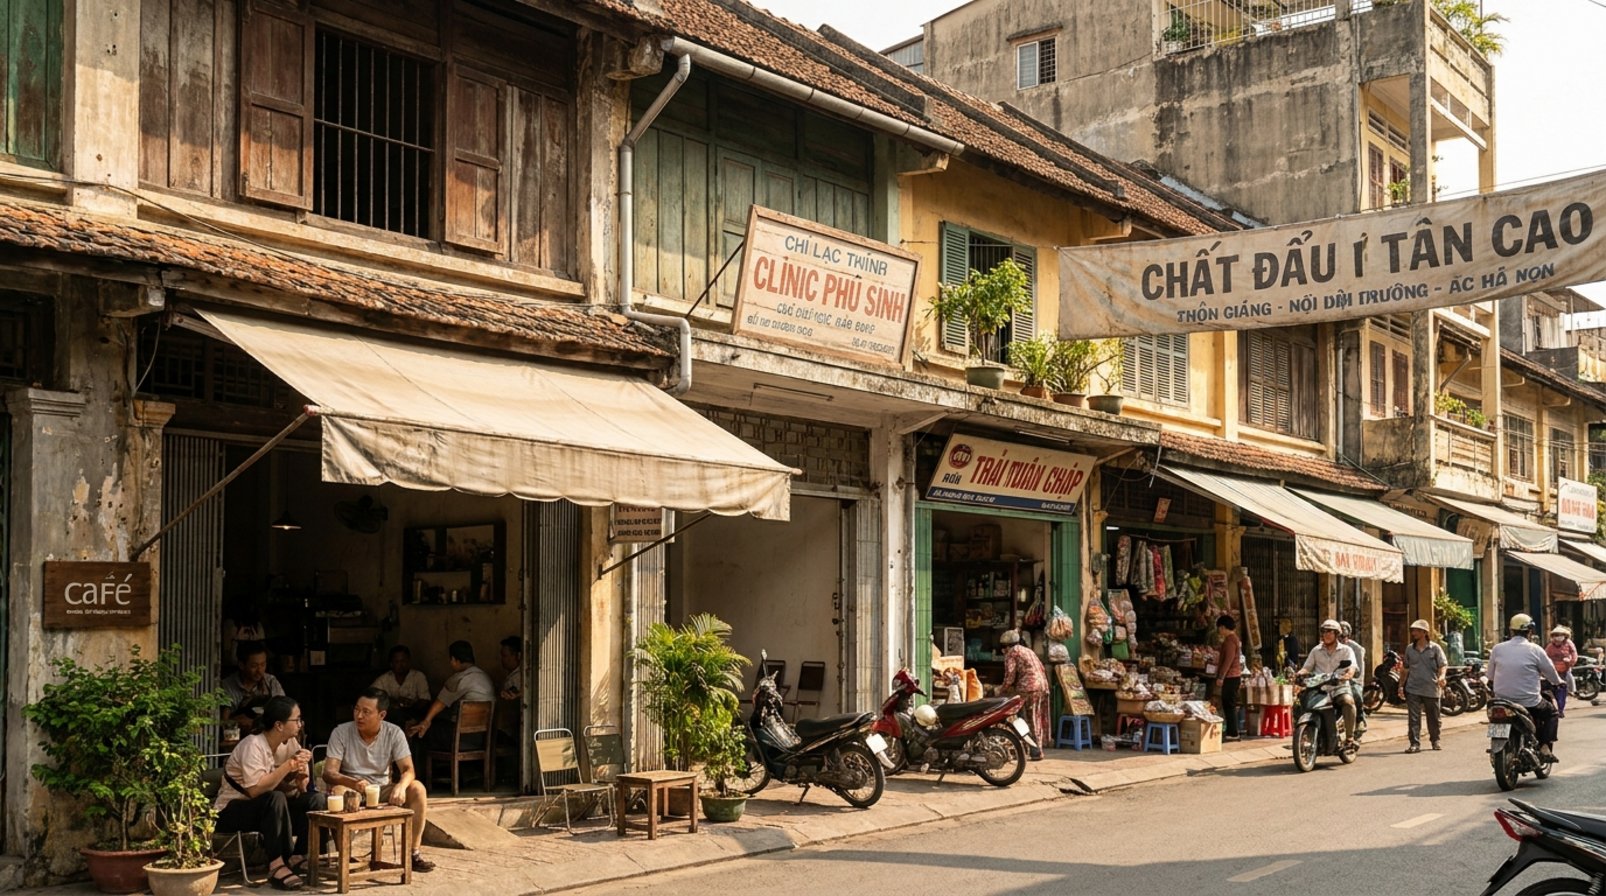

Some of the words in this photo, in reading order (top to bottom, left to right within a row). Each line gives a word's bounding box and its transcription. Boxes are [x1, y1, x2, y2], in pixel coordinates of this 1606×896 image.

[1141, 240, 1239, 301] CHẤT
[1381, 216, 1474, 274] TÂN
[1491, 201, 1594, 258] CAO
